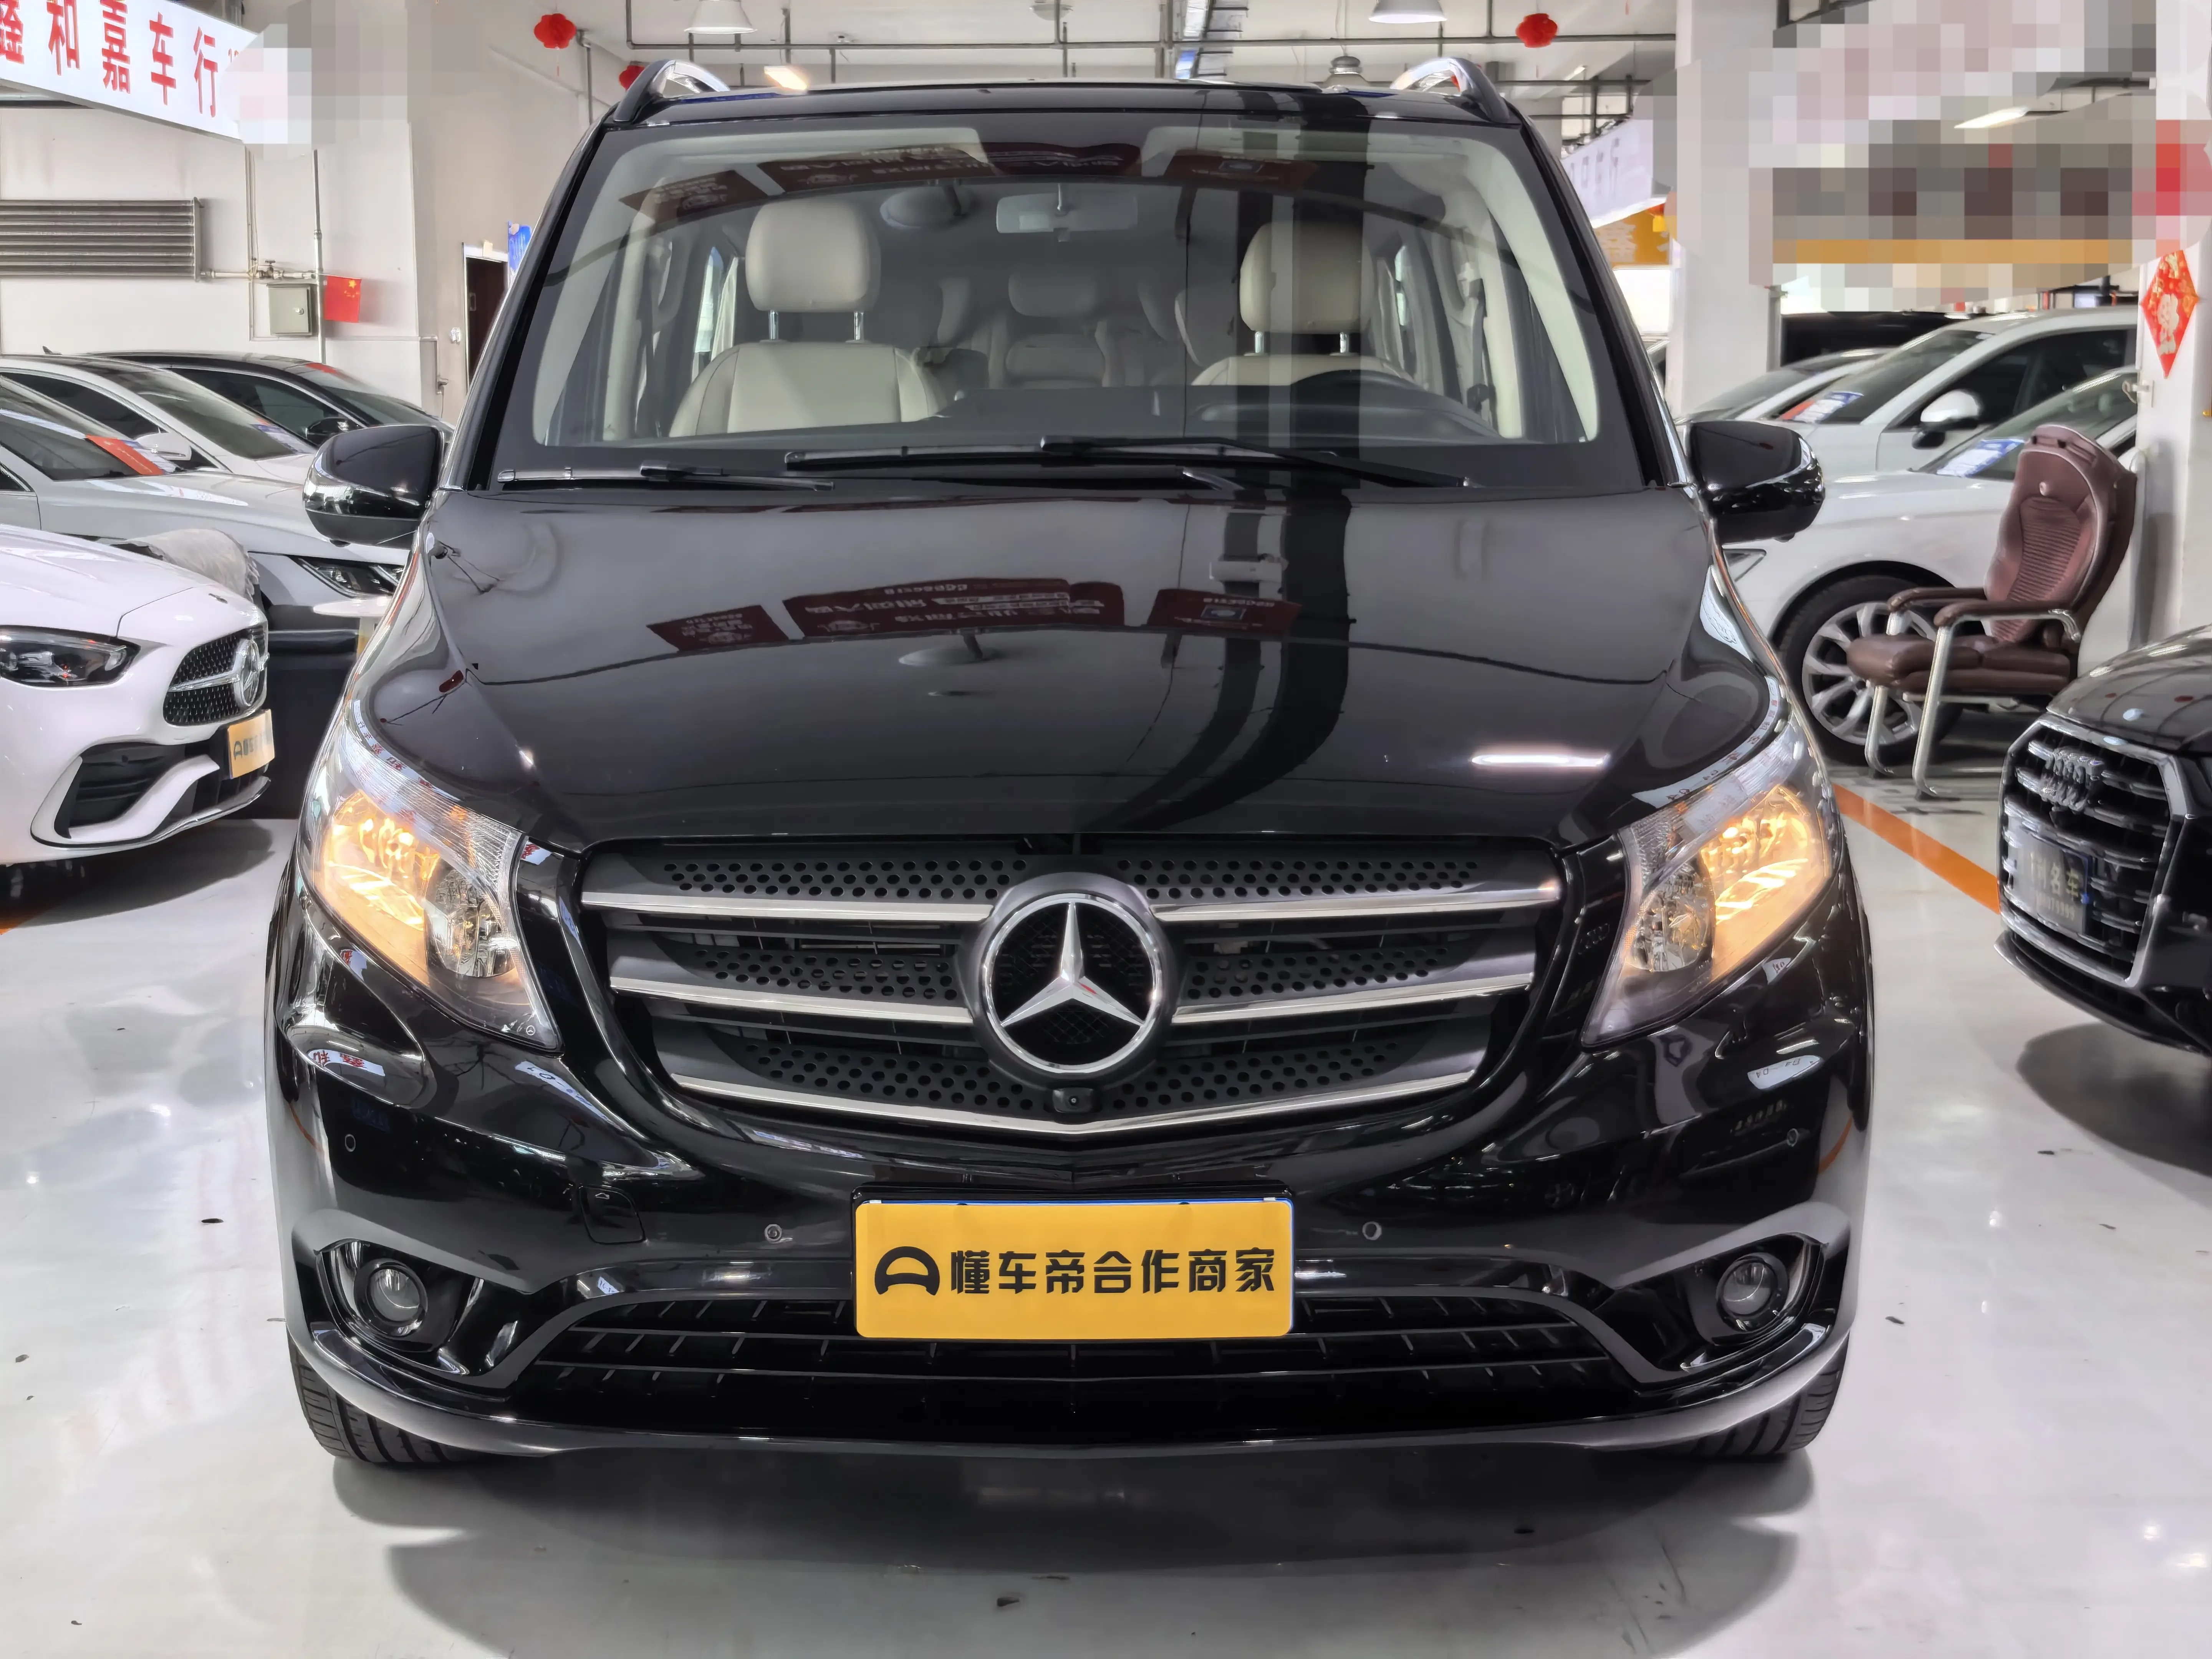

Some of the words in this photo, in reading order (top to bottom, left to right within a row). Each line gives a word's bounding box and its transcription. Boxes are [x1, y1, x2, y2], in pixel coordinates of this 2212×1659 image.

[951, 1248, 1275, 1294] 懂车帝合作商家
